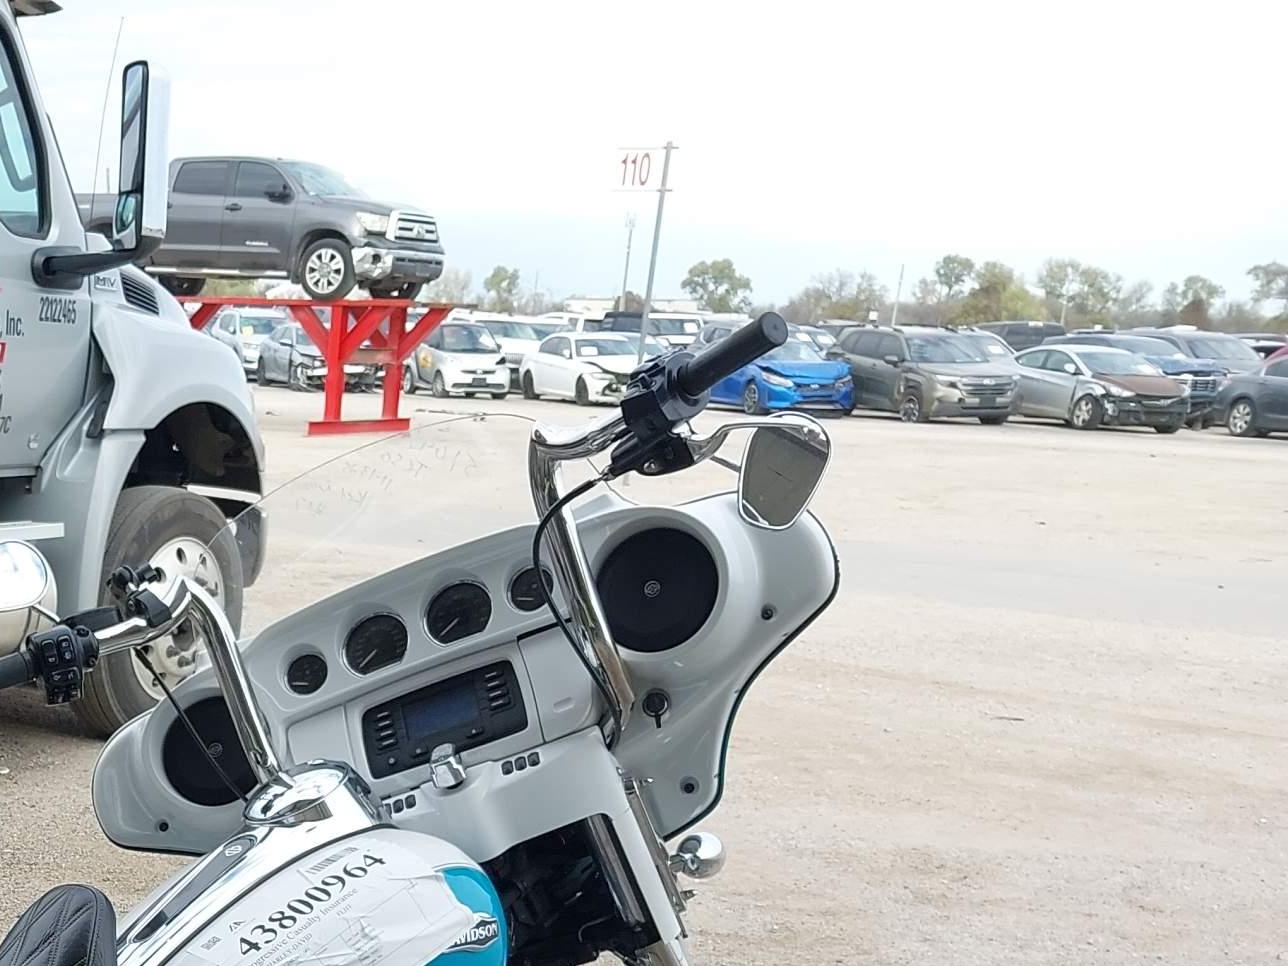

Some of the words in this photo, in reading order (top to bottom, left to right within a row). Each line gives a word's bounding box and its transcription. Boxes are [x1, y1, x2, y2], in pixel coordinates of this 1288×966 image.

[621, 152, 651, 186] 110
[5, 308, 25, 337] Inc.
[238, 853, 387, 956] 43800964
[286, 913, 322, 940] Casualty
[321, 887, 359, 917] Insurance
[452, 922, 499, 946] AVIDSON
